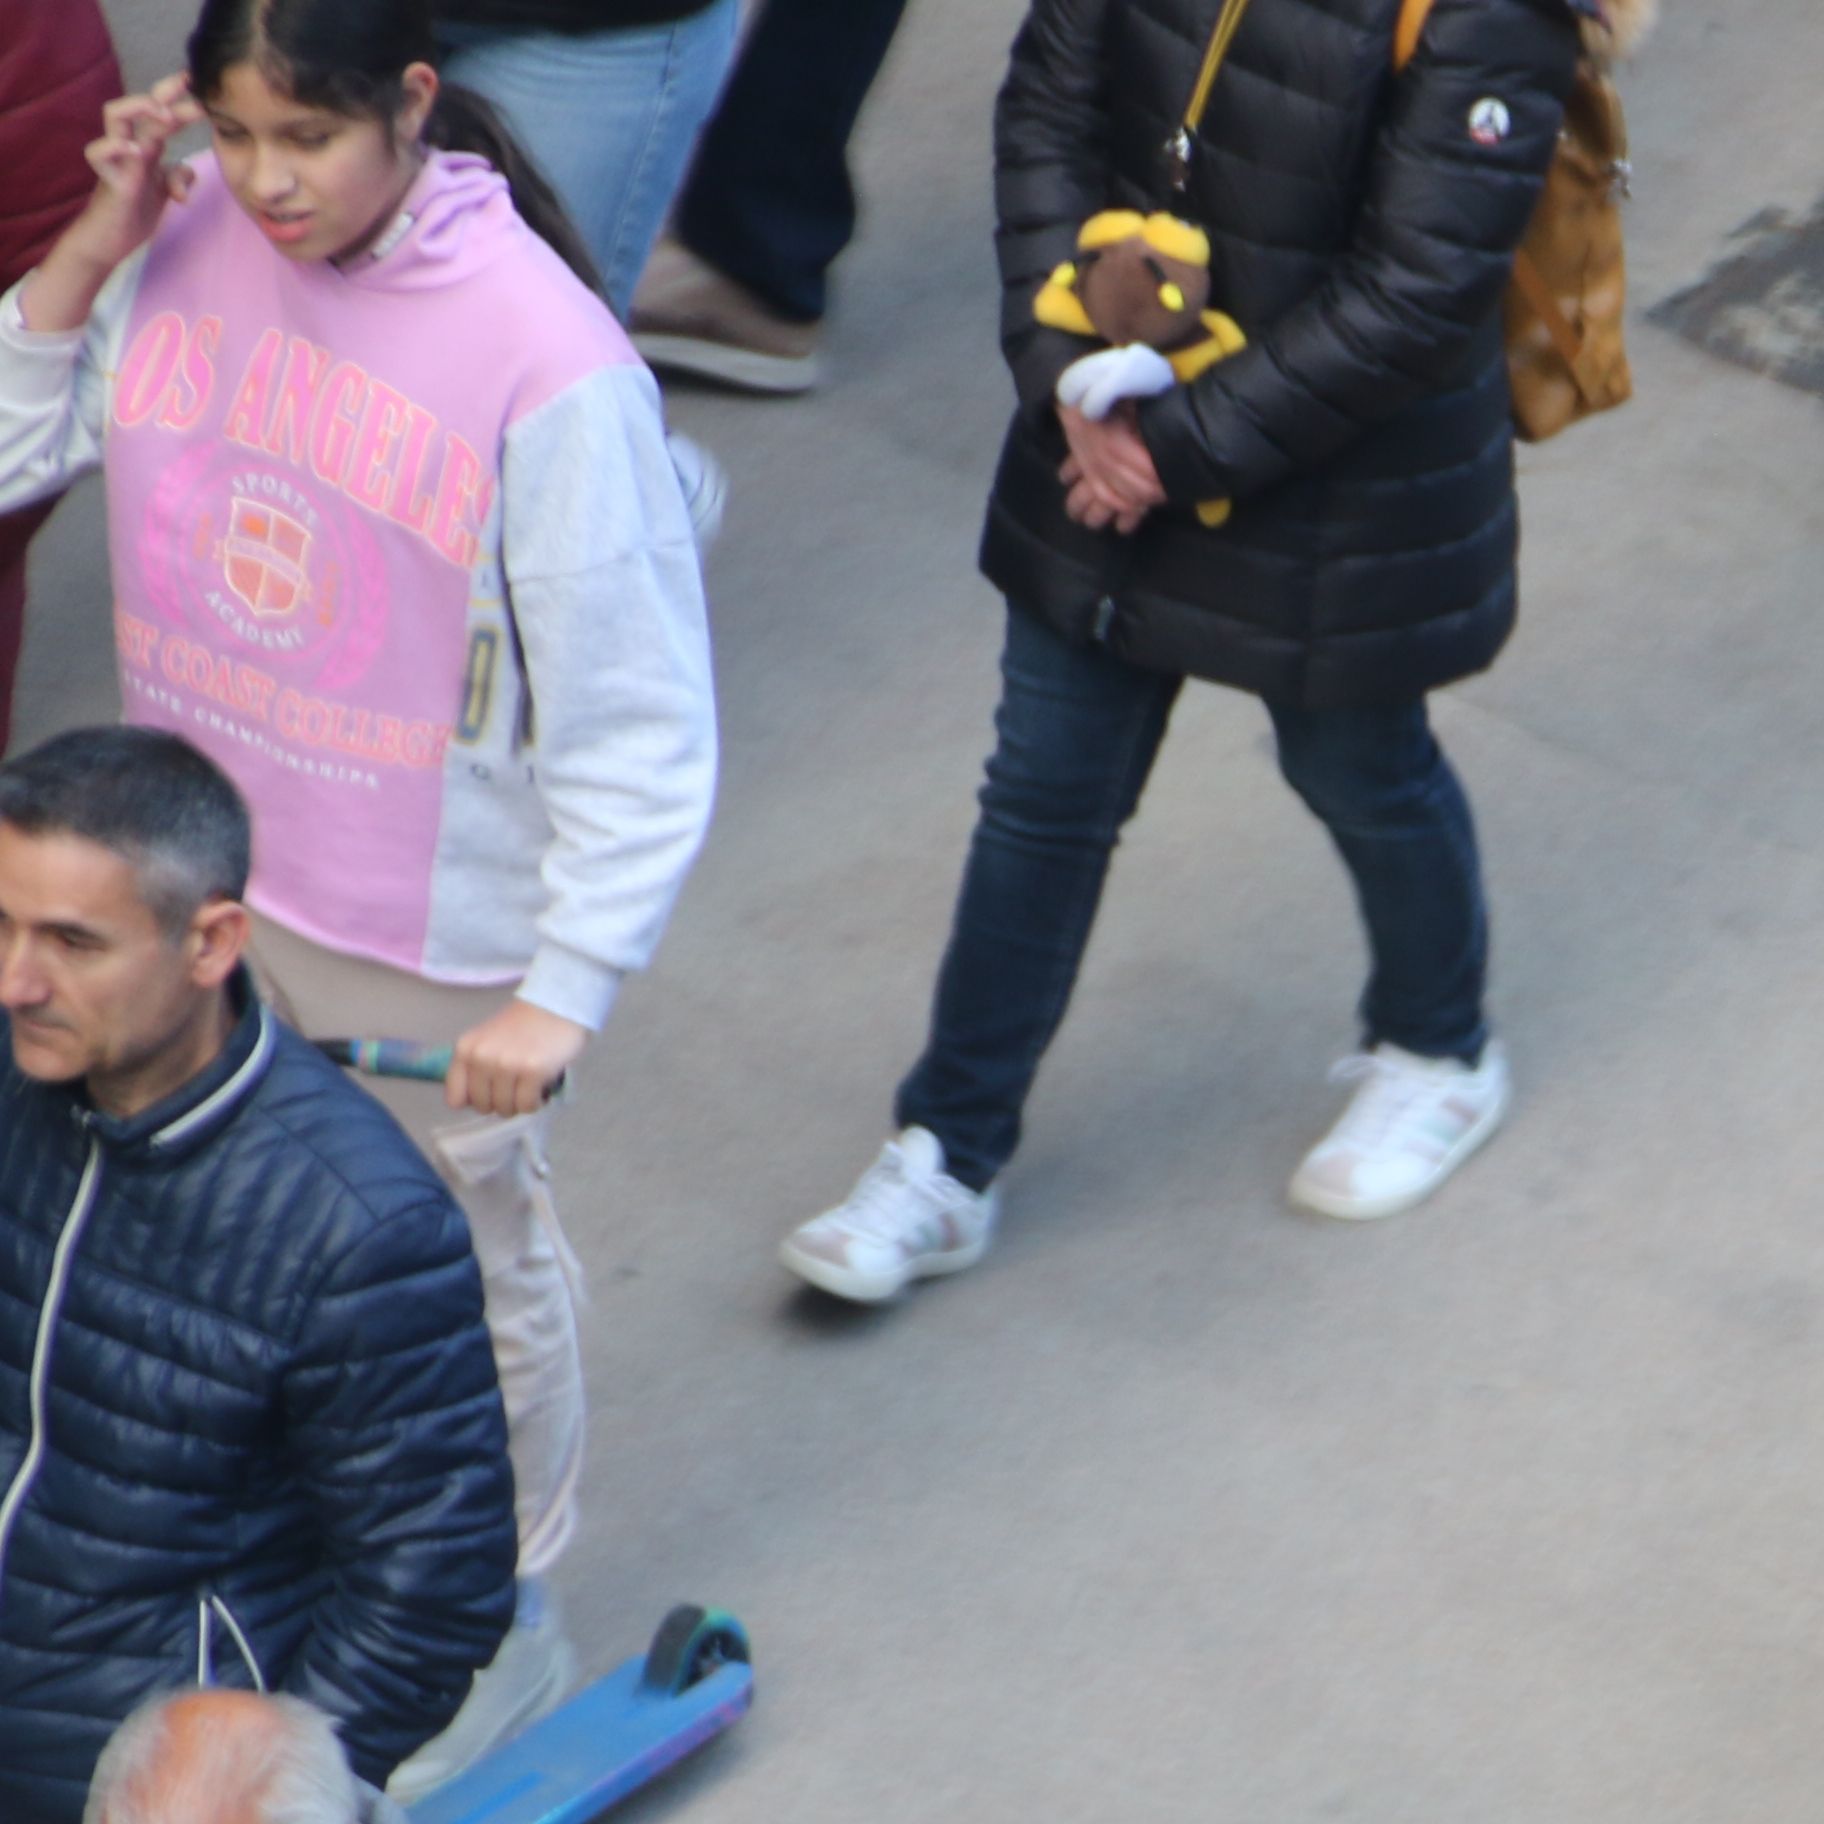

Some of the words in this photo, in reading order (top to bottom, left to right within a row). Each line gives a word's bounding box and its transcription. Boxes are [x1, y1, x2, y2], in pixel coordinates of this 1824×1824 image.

[232, 472, 318, 527] SPORTS
[206, 591, 305, 649] ACADEMY
[161, 635, 276, 722] COAST
[194, 706, 380, 790] CHAMPIONSHIPS
